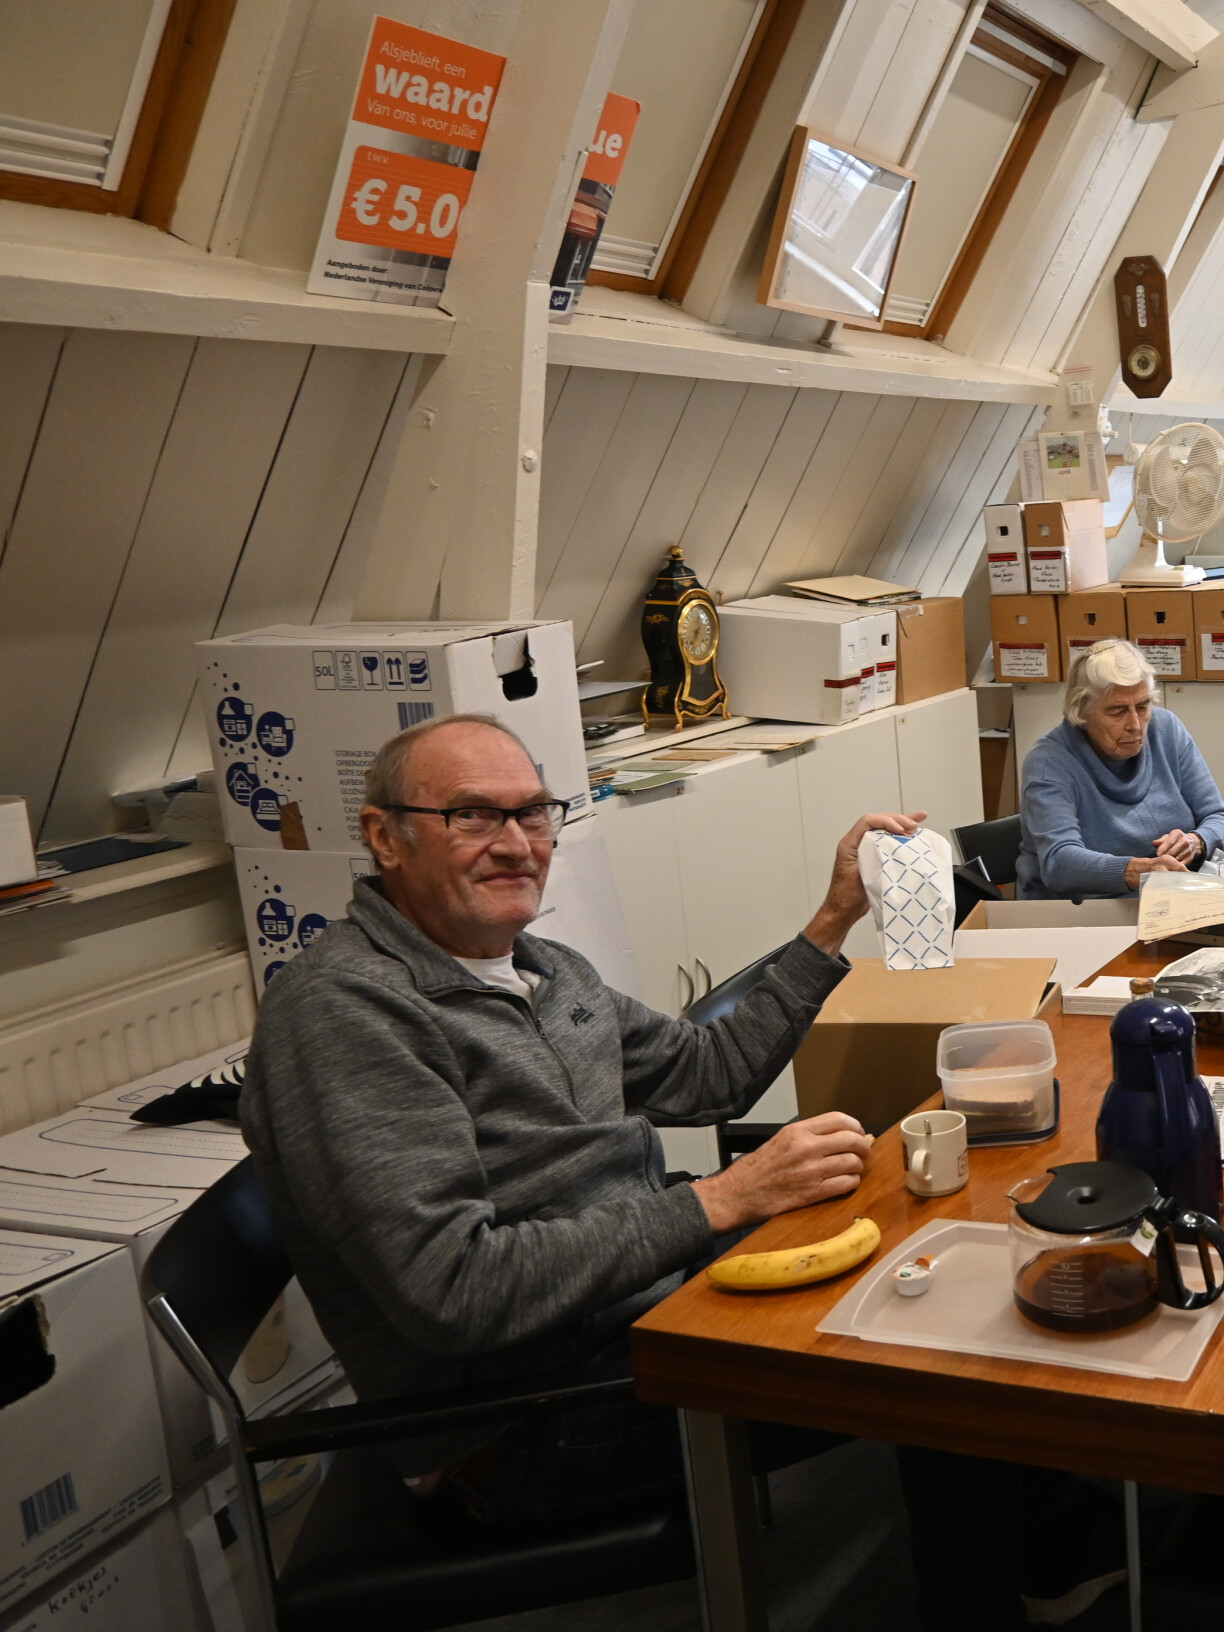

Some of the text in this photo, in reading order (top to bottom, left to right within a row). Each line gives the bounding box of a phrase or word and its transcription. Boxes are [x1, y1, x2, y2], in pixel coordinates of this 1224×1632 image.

[444, 63, 466, 78] een
[367, 98, 478, 140] Van ons, voor jullie
[326, 259, 369, 272] Aangeboden
[324, 271, 367, 284] Nederlandse
[368, 277, 403, 290] Vereniging
[404, 281, 418, 290] van
[315, 666, 336, 678] 50L
[335, 750, 363, 758] STORAGE
